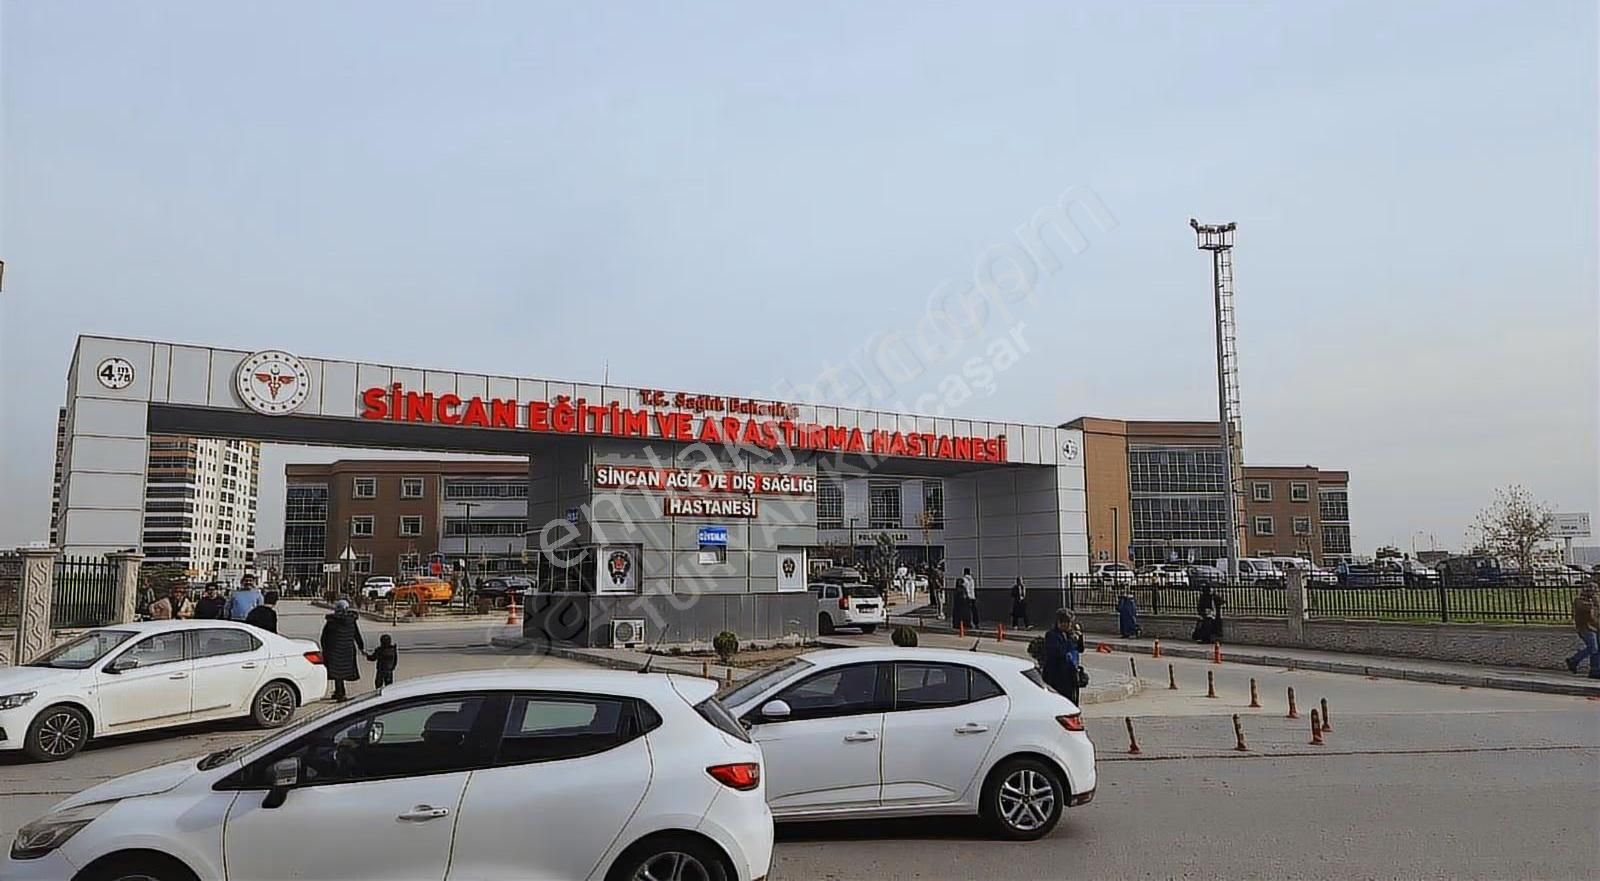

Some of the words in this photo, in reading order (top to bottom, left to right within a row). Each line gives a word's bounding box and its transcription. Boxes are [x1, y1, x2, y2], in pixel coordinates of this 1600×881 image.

[360, 382, 518, 429] SİNCAN
[527, 394, 648, 437] EĞİTİM
[655, 410, 693, 441] VE
[699, 415, 866, 452] ARAŞTIRMA
[871, 427, 1008, 464] HASTANESİ
[596, 466, 661, 487] SİNCAN
[666, 470, 702, 489] AĞIZ
[706, 474, 728, 490] VE
[732, 473, 756, 494] DİŞ
[761, 476, 818, 495] SAĞLIĞI
[669, 497, 757, 517] HASTANESİ
